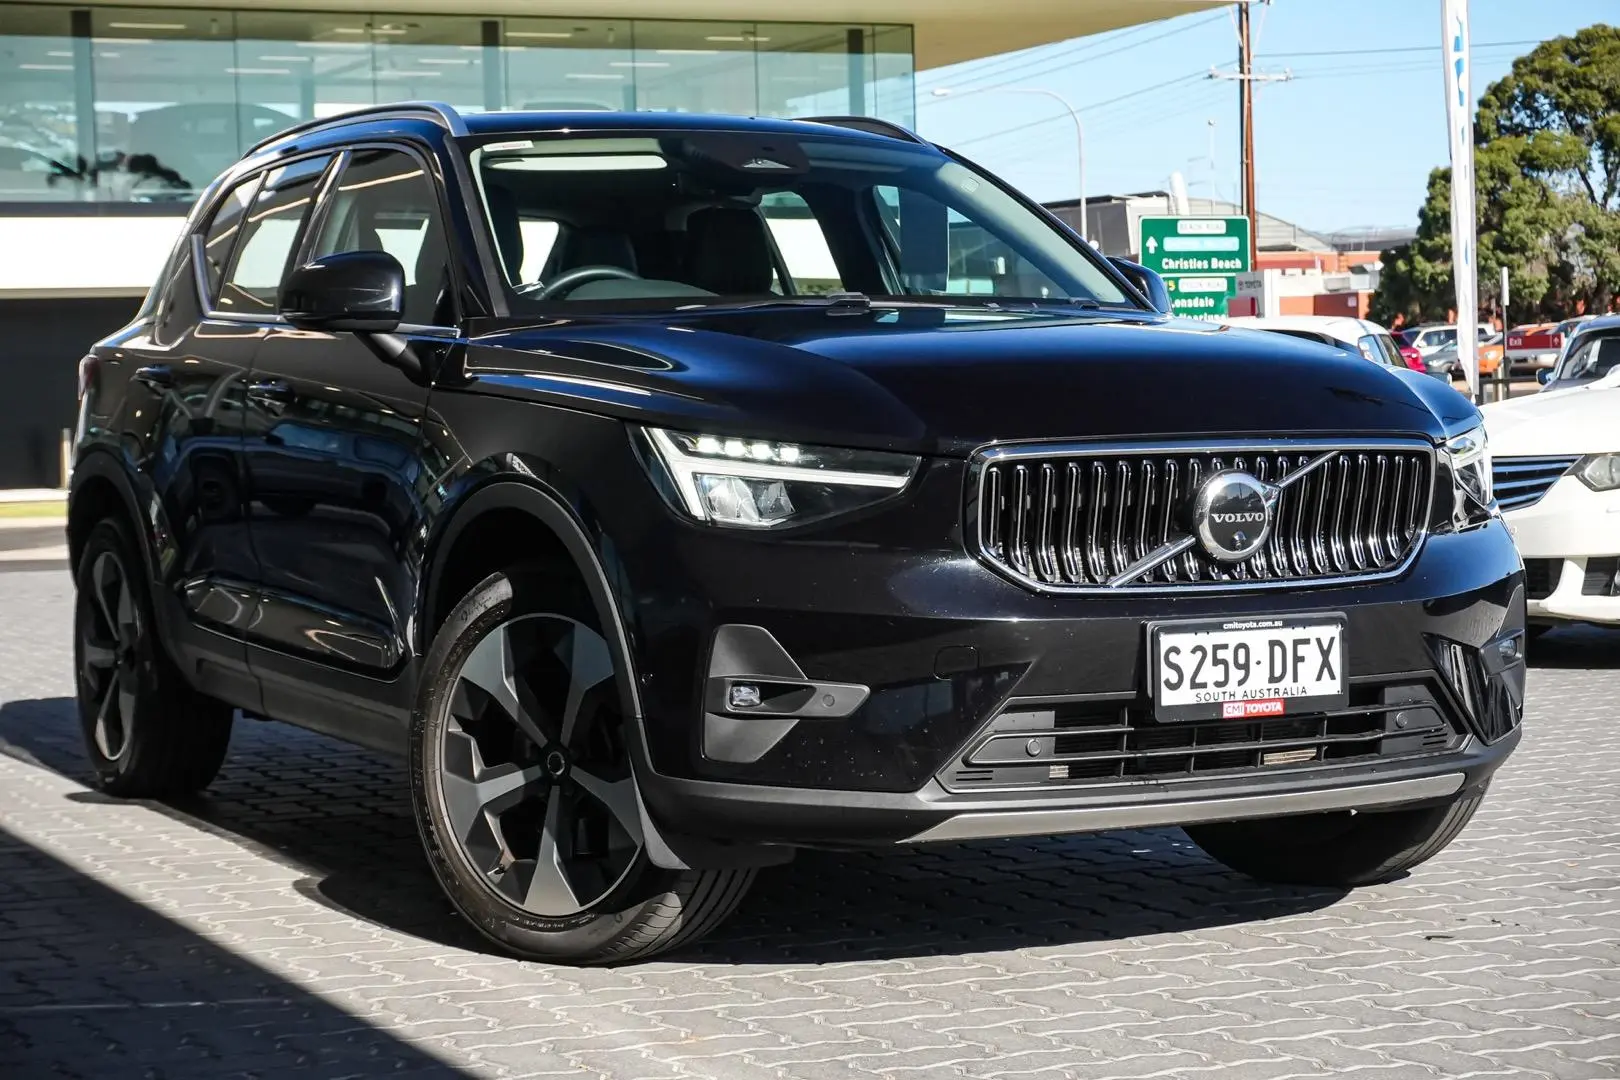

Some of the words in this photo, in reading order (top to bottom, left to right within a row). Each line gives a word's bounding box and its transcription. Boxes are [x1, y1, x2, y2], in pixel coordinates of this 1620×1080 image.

[1161, 257, 1209, 270] Christies
[1210, 257, 1242, 270] Beach
[1171, 296, 1215, 308] onsdale
[1509, 337, 1522, 346] Exit
[1211, 512, 1265, 523] VOLVO
[1223, 619, 1283, 630] cmitoyota.com.au
[1195, 690, 1236, 702] SOUTH
[1242, 686, 1308, 699] AUSTRALIA
[1244, 701, 1284, 713] TOYOTA
